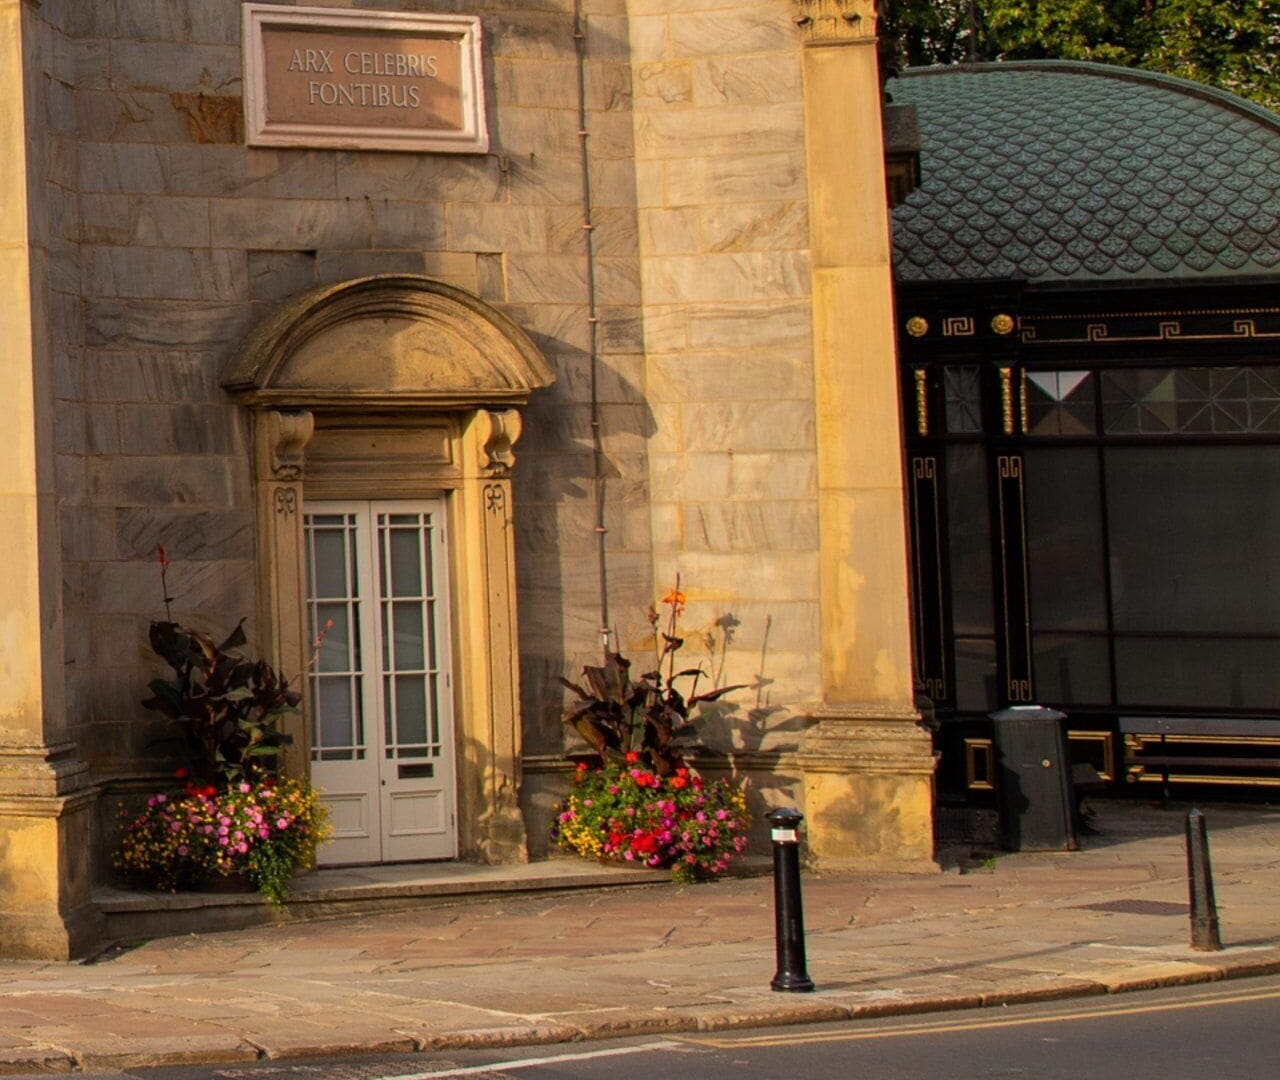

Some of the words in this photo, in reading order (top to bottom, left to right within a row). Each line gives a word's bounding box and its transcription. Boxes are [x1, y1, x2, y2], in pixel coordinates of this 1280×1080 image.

[289, 48, 334, 73] ARX
[344, 51, 438, 77] CELEBRIS
[309, 81, 421, 108] FONTIBUS
